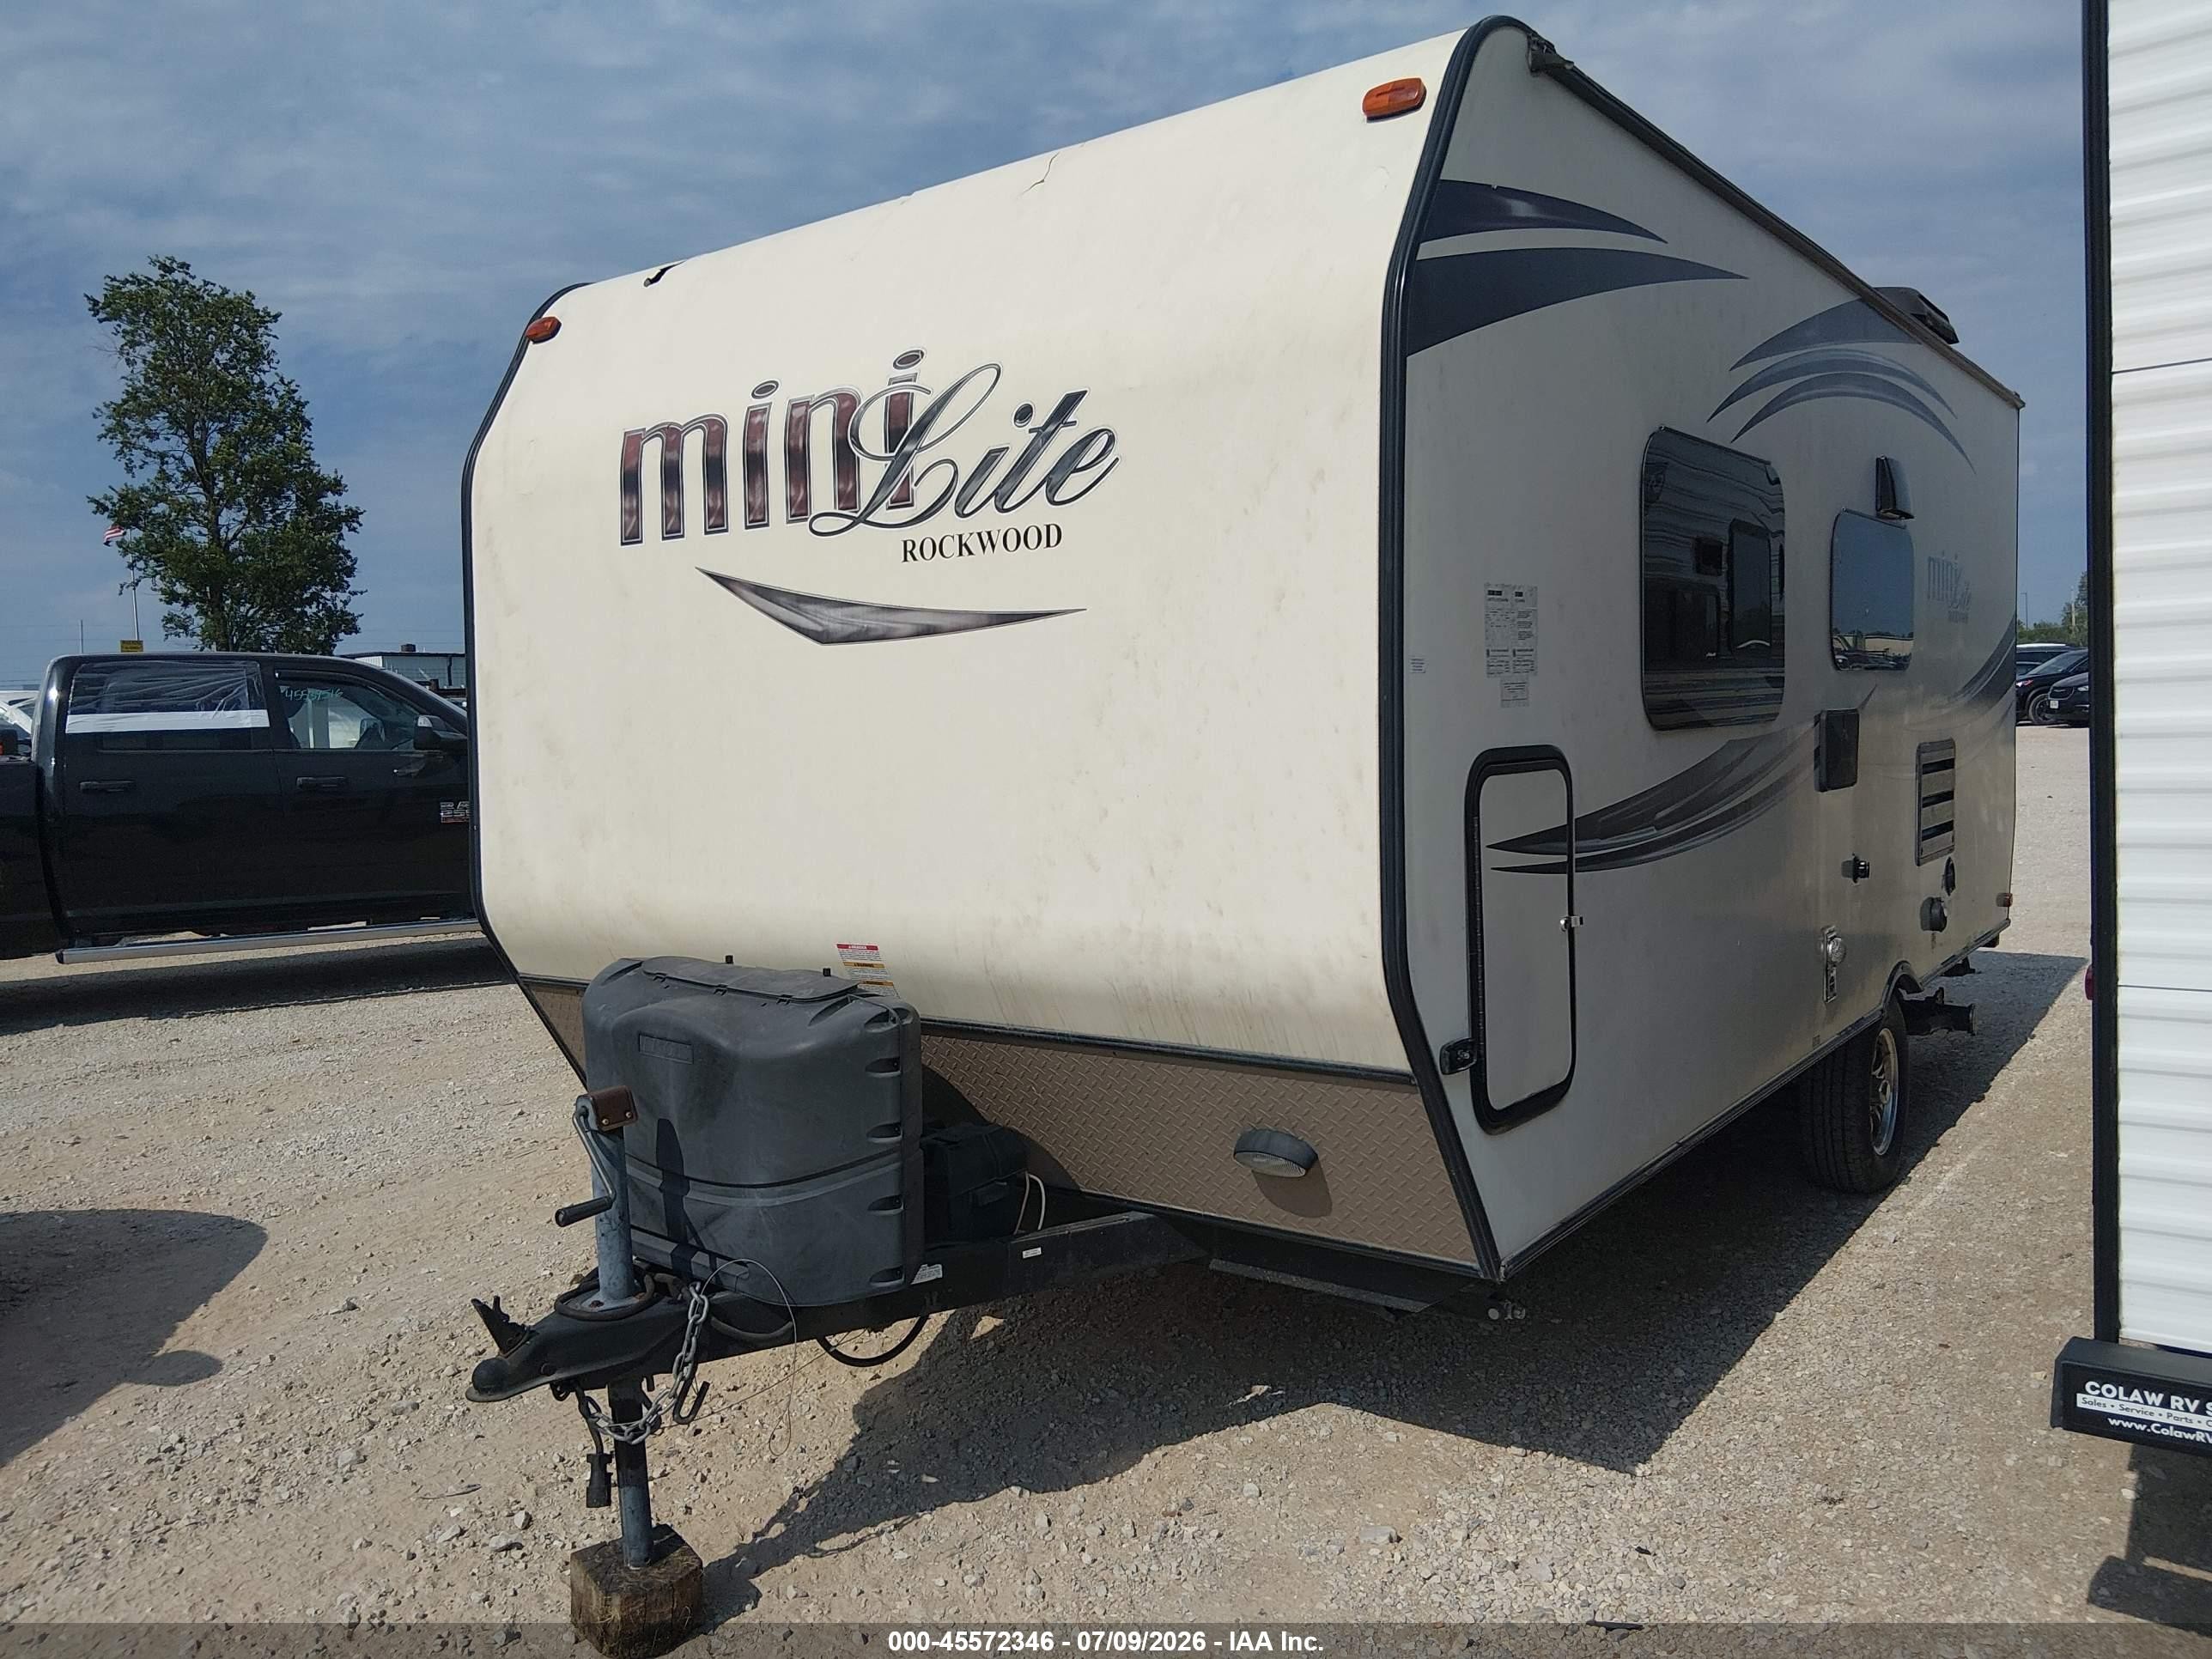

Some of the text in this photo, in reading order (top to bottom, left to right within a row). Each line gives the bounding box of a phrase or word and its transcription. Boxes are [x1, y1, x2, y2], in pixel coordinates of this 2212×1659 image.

[619, 349, 1120, 546] mini Lite
[901, 523, 1063, 563] ROCKWOOD
[2081, 1397, 2106, 1408] Sales
[2118, 1403, 2154, 1417] Service
[2166, 1412, 2193, 1425] Parts
[2085, 1381, 2164, 1407] COLAW
[2170, 1395, 2200, 1413] RV
